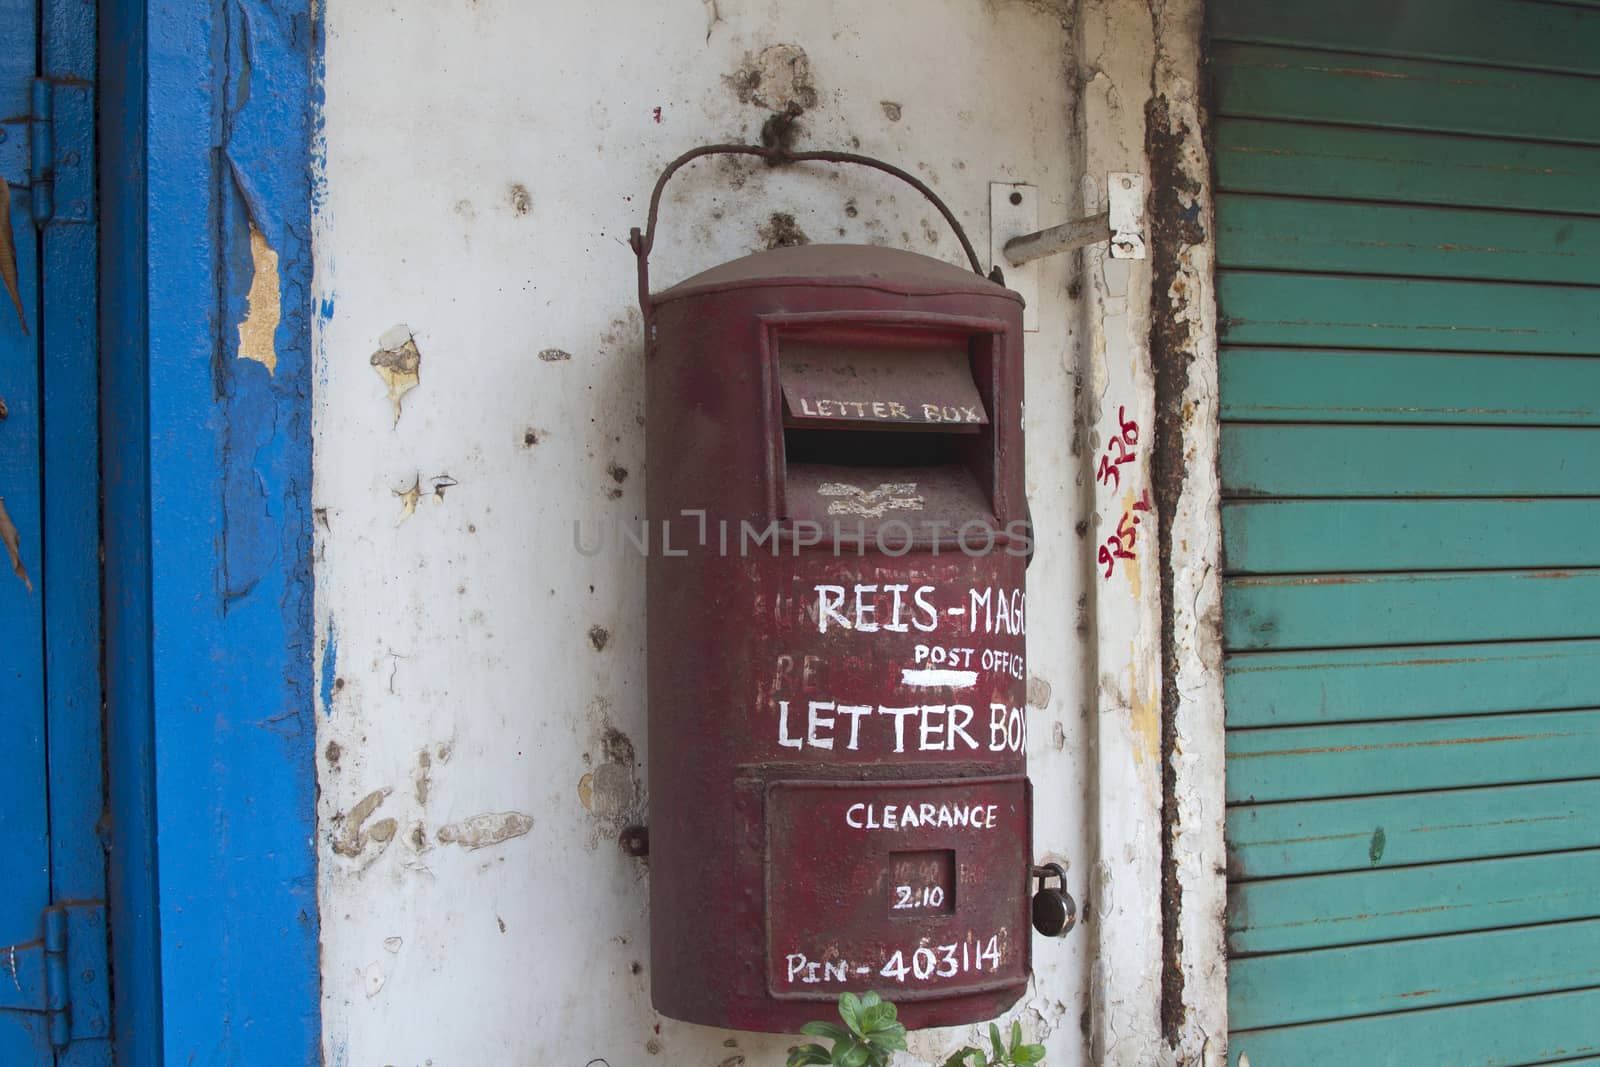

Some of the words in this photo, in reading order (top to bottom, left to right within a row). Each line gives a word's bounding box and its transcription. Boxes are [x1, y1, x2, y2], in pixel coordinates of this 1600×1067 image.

[800, 398, 911, 420] LETTER
[921, 403, 982, 423] BOX
[914, 644, 975, 668] POST
[981, 648, 1024, 680] OFFICE
[777, 700, 979, 753] LETTER
[846, 802, 998, 829] CLEARANCE
[892, 885, 945, 910] 2.10
